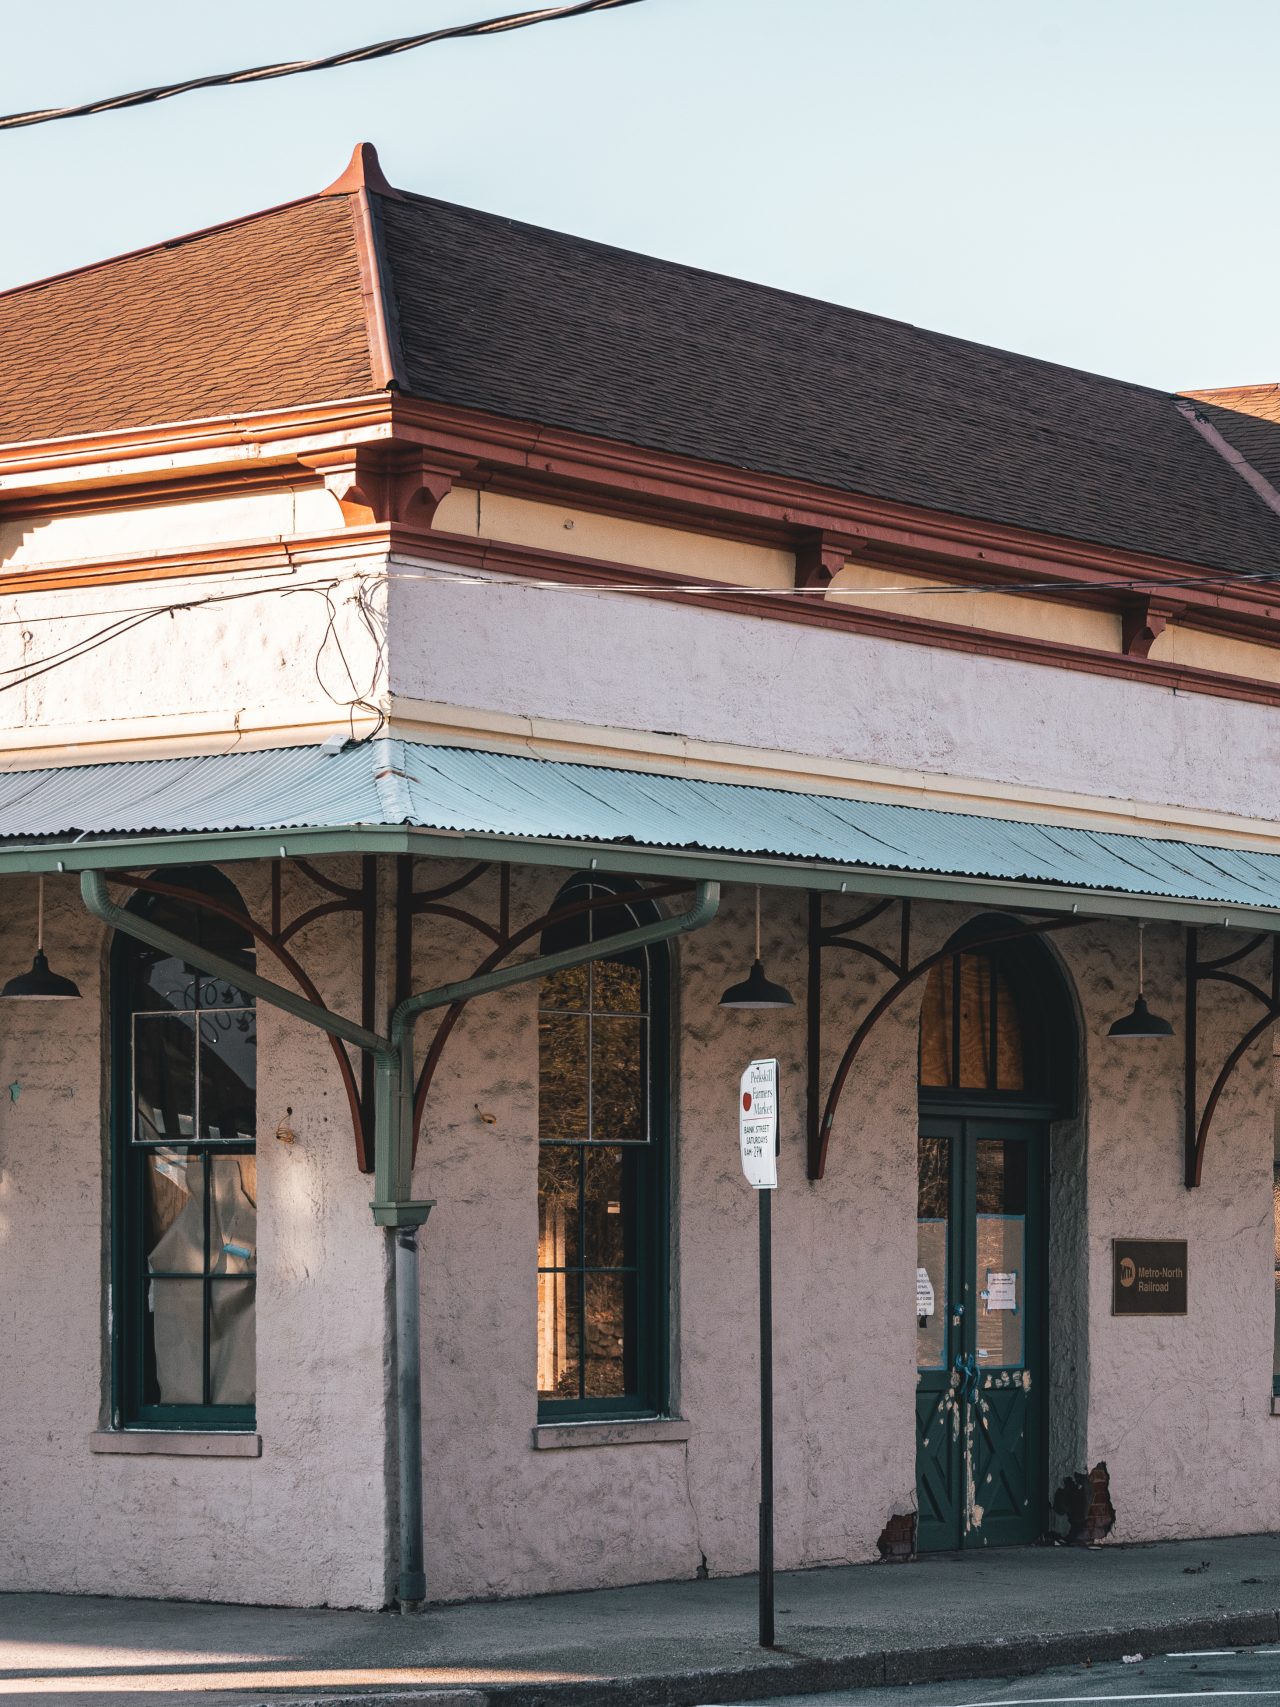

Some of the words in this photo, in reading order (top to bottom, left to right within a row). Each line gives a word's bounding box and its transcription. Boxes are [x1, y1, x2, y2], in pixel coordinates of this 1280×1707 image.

[751, 1069, 773, 1084] Peekskill
[752, 1087, 773, 1100] Farmers
[754, 1102, 773, 1115] Market
[755, 1124, 770, 1133] STREET
[1138, 1267, 1183, 1278] Metro-North
[1138, 1281, 1169, 1292] Railroad
